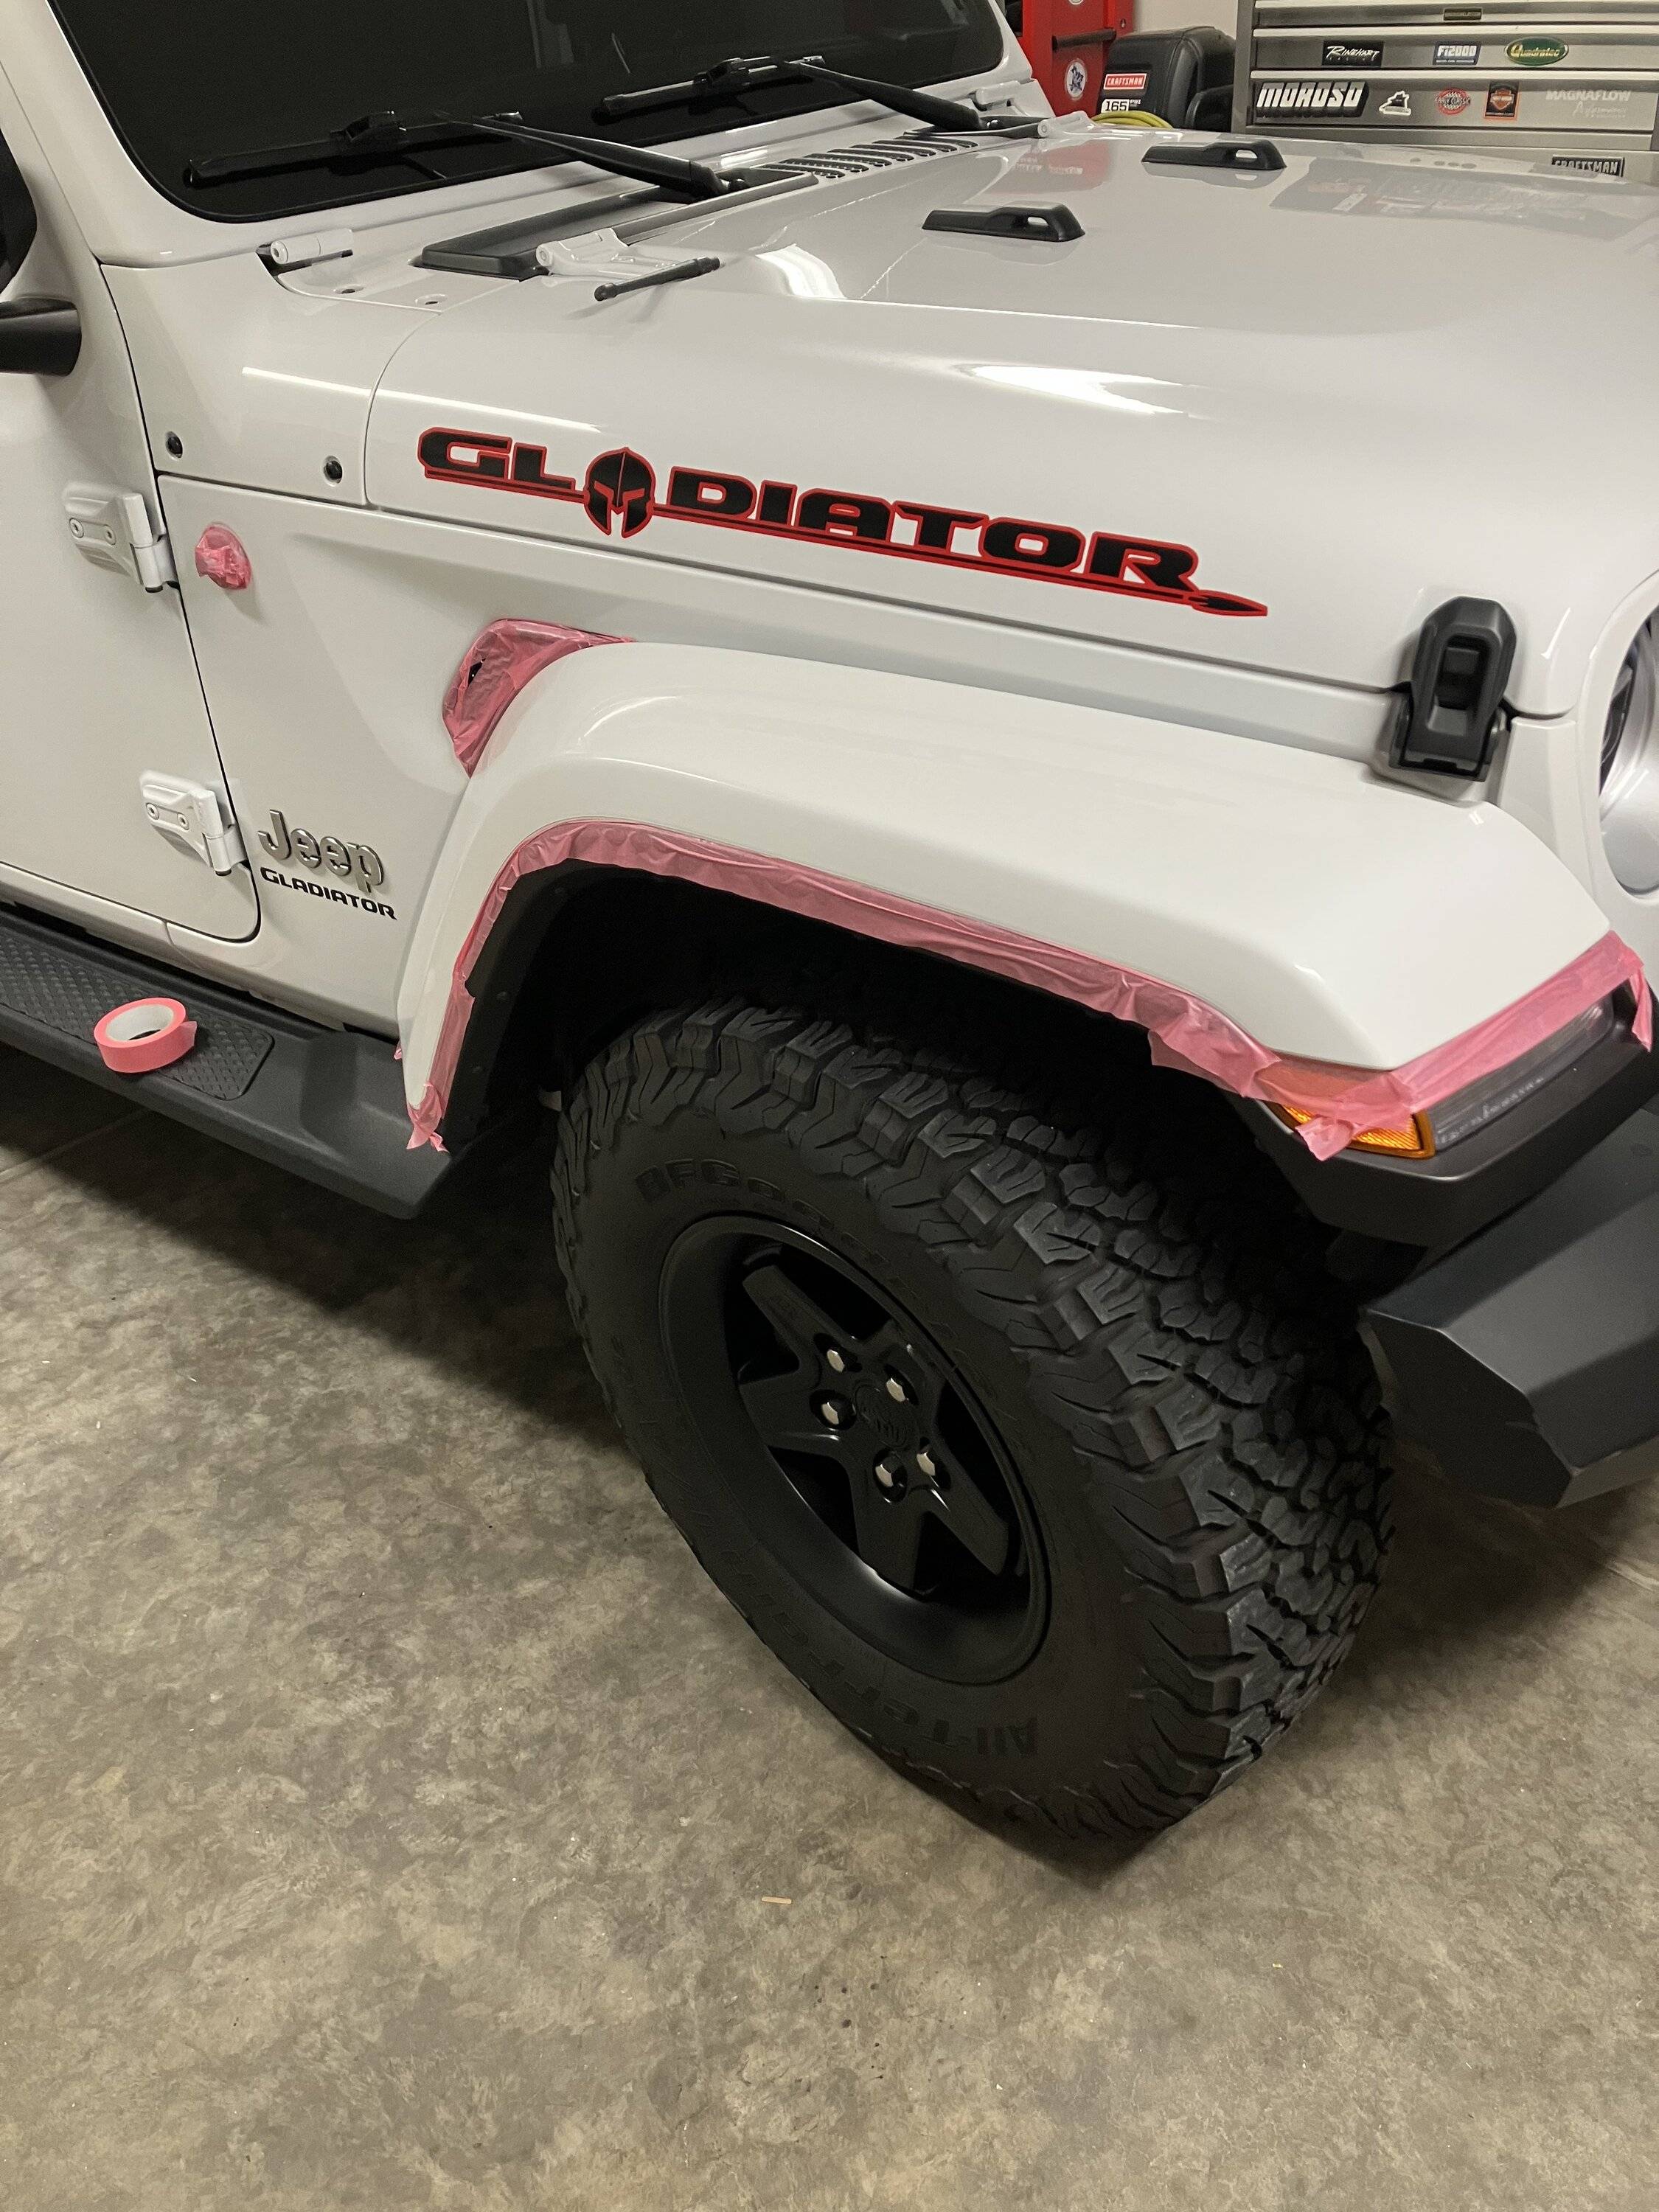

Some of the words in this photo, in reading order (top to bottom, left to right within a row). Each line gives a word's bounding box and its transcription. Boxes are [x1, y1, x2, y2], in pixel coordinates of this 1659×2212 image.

[1106, 77, 1144, 86] CRAFTSMAN
[1256, 82, 1365, 108] MOROSO
[1545, 90, 1631, 102] MAGNAFLOW
[1105, 100, 1127, 111] 165
[1555, 159, 1618, 174] CRAFTSMAN
[258, 809, 384, 893] Jeep
[260, 866, 397, 921] GLADIATOR
